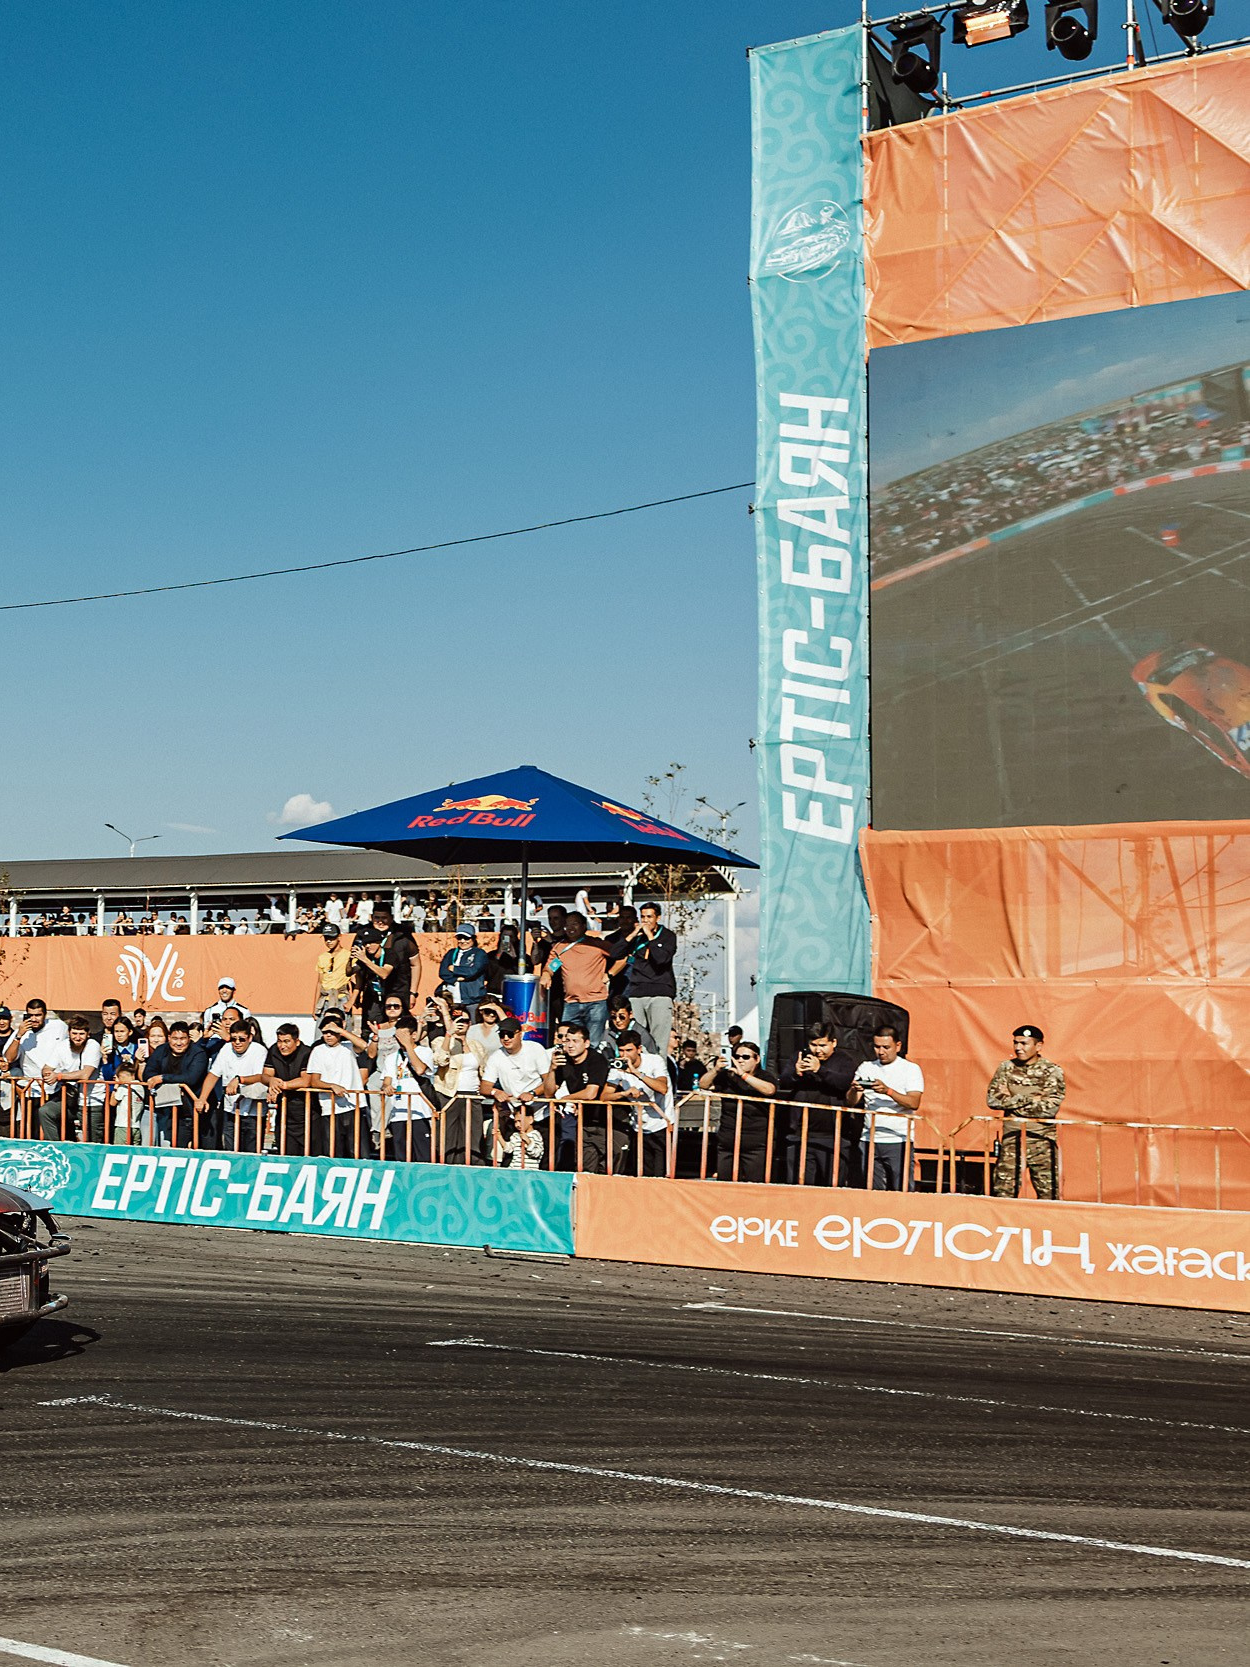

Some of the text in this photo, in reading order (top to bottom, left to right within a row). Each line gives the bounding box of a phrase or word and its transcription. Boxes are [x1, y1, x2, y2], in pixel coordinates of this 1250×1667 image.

[777, 392, 853, 844] ЕРТІС-БАЯН
[407, 812, 537, 828] Red Bull
[91, 1153, 396, 1230] ЕРТІС-БАЯН
